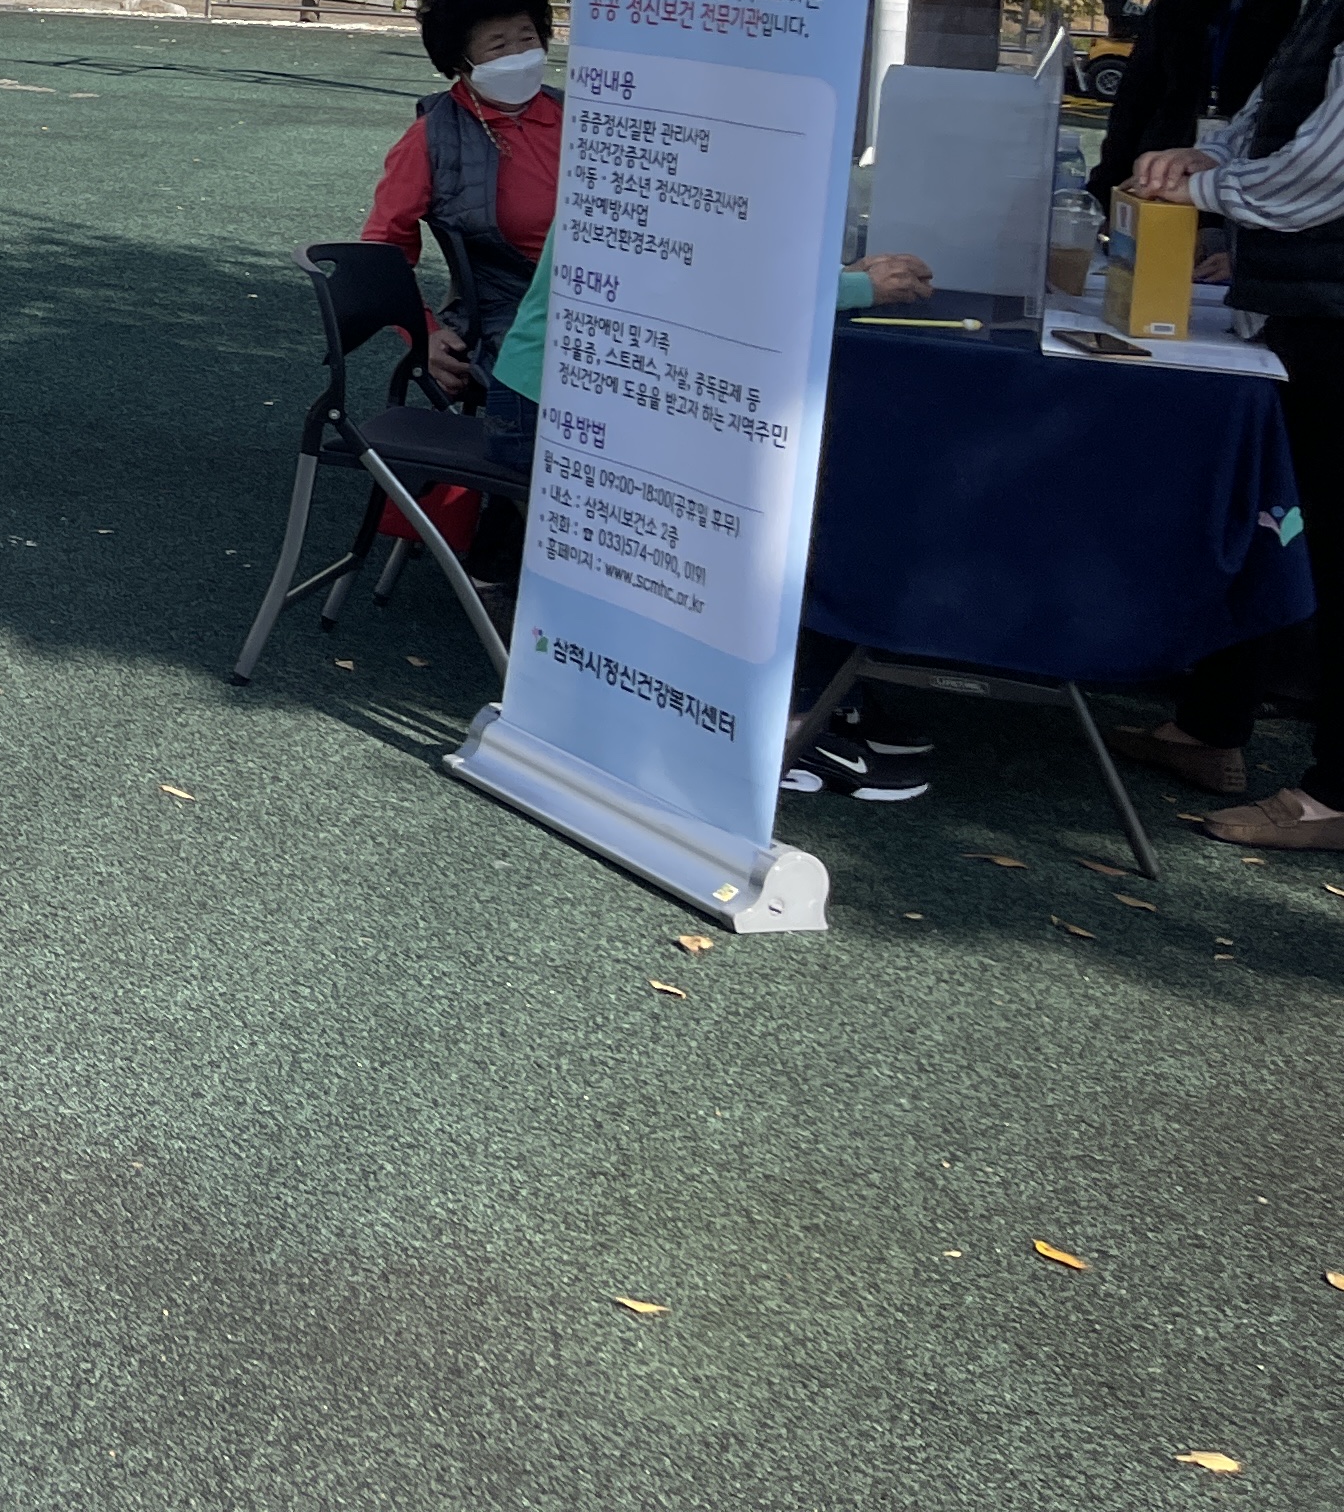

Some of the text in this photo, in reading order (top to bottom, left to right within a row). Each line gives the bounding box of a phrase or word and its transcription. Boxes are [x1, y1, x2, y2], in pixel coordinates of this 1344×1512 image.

[699, 3, 810, 38] 전문기관입니다.
[576, 66, 637, 100] 사업내용
[577, 137, 679, 176] 정신건강증진사업
[659, 122, 711, 153] 관리사업
[572, 192, 649, 227] 자살예방사업
[575, 164, 598, 190] 아동
[611, 170, 652, 199] 청소년
[655, 178, 749, 220] 정신건강증진사업
[570, 219, 694, 266] 정신보건환경조성사업
[561, 264, 621, 303] 이용대상
[563, 308, 671, 356] 정신장애인 및 가족
[604, 348, 661, 381] 스트레스,
[664, 363, 691, 391] 자살,
[694, 371, 743, 404] 중독문제
[746, 387, 762, 413] 등
[559, 362, 789, 450] 정신건강에 도움을 받고자 하는 지역주민
[549, 408, 607, 450] 이용방법
[549, 484, 573, 508] 내소
[584, 496, 657, 536] 삼척시보건소
[661, 522, 680, 550] 2층
[546, 537, 594, 571] 홈페이지
[547, 510, 571, 534] 전화
[683, 561, 706, 587] 0191
[553, 636, 736, 743] 삼척시정신건강복지센터
